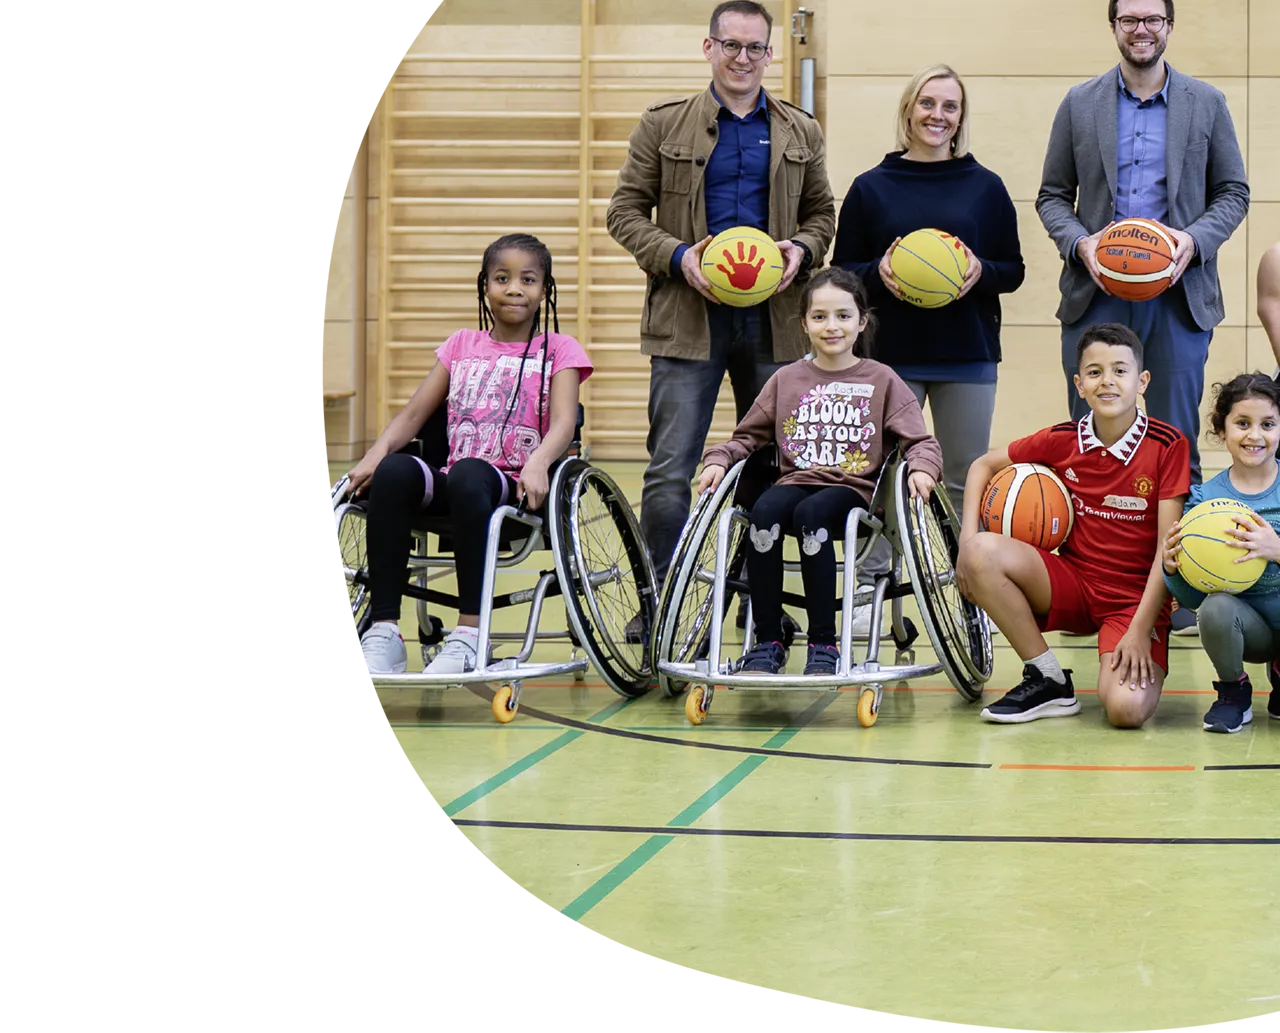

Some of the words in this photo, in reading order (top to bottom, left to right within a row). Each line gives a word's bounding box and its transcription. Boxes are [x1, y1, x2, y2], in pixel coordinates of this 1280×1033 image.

[1107, 227, 1159, 246] molten
[797, 400, 861, 426] BLOOM
[792, 424, 819, 441] AS
[823, 425, 863, 443] YOU
[801, 440, 849, 466] ARE
[1111, 498, 1137, 508] Adam
[1084, 505, 1146, 522] TeamViewer
